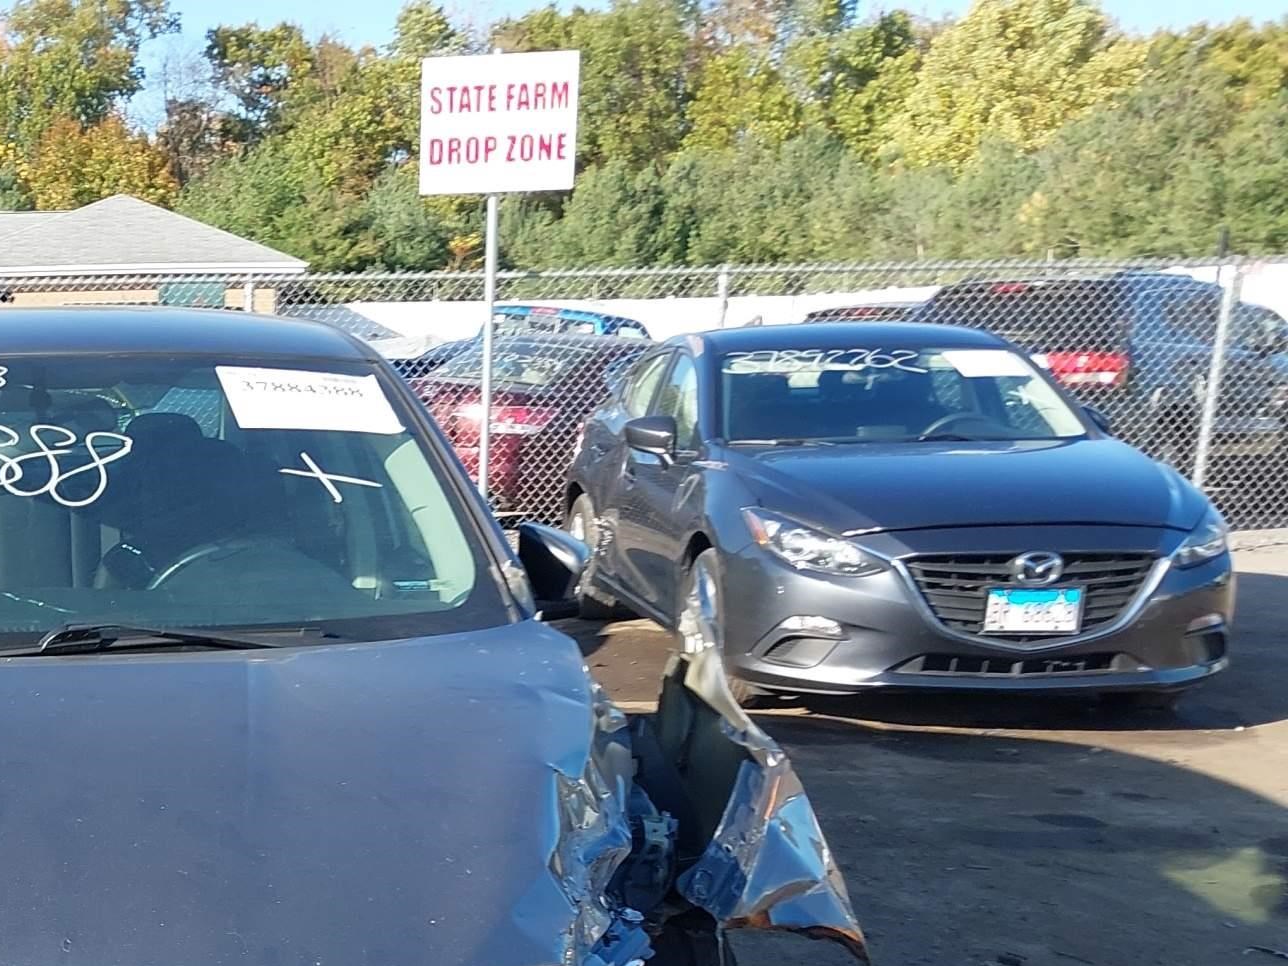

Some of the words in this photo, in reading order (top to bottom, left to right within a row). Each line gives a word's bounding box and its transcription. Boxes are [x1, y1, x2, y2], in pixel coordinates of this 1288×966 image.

[431, 85, 496, 114] STATE
[507, 82, 569, 110] FARM
[430, 137, 497, 164] DROP
[507, 133, 567, 161] ZONE
